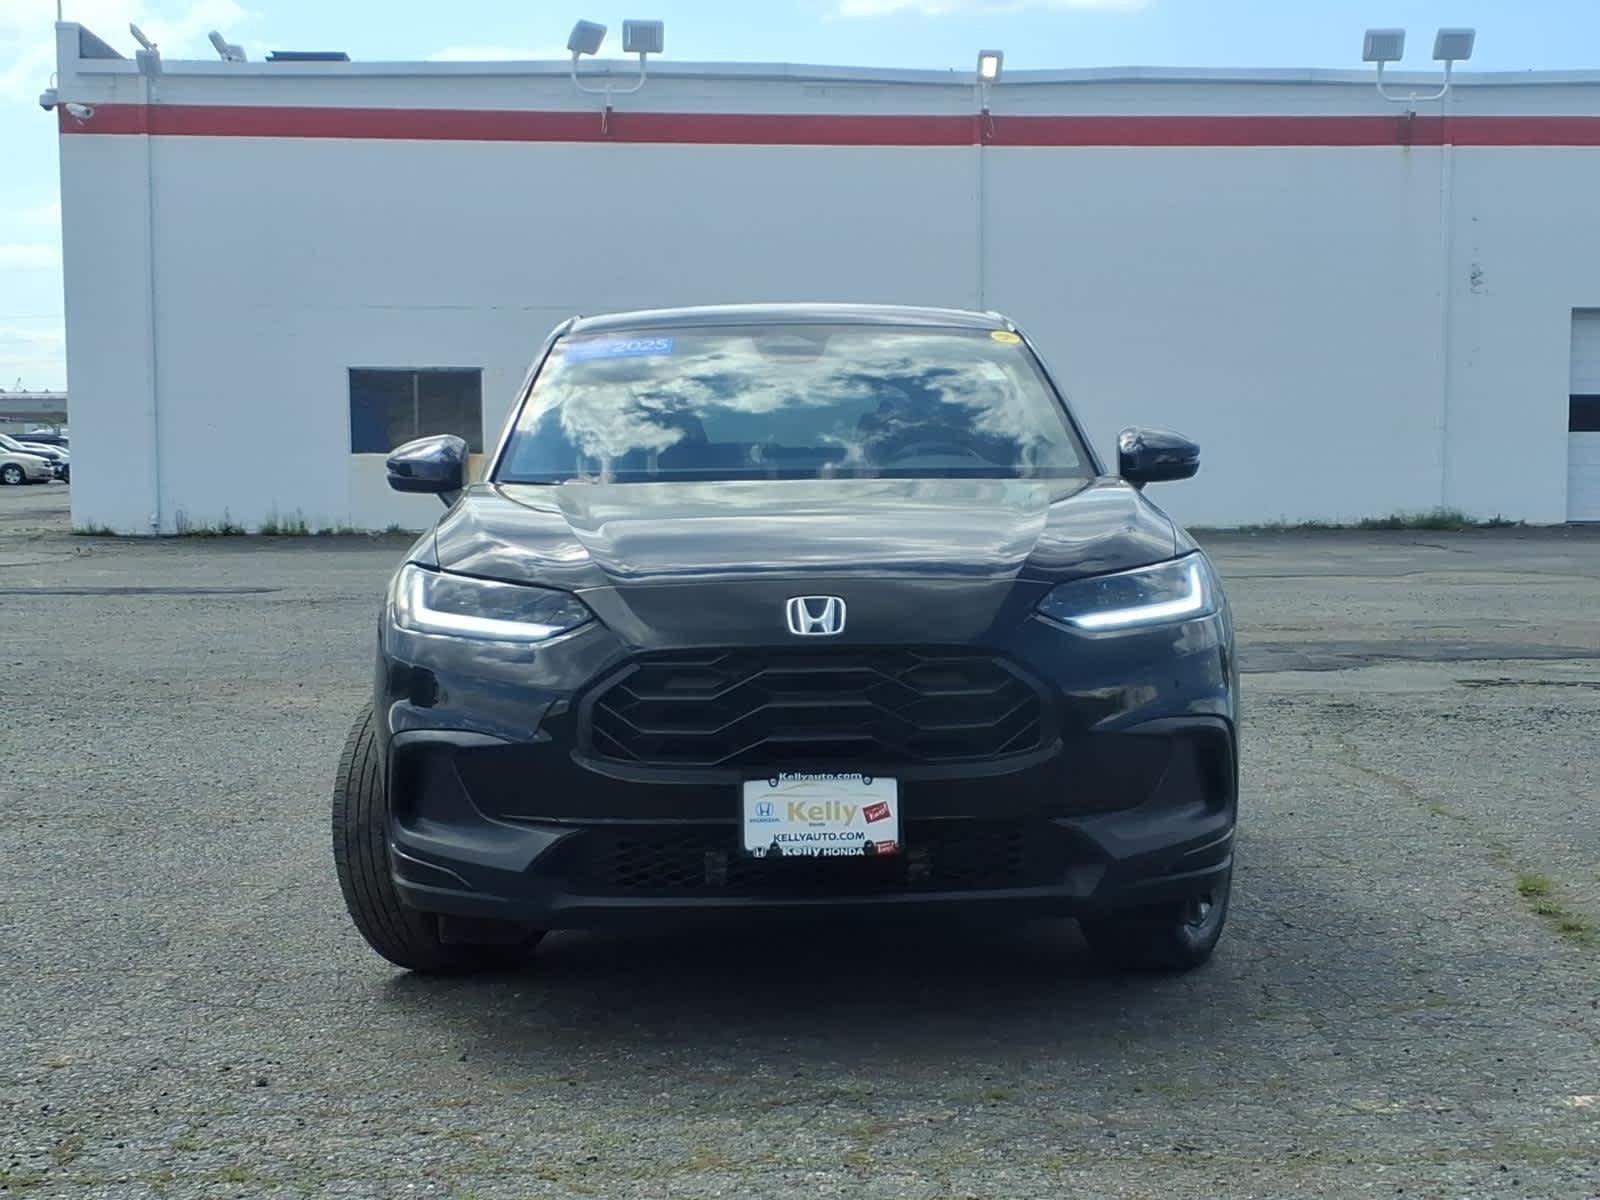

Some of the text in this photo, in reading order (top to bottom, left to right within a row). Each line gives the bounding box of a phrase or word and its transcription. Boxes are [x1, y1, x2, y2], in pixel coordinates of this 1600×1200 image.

[613, 338, 668, 353] 2025
[779, 772, 862, 781] Kellyauto.com
[787, 801, 858, 827] Kelly
[774, 832, 865, 842] KELLYAUTO.COM
[782, 846, 865, 857] Kelly HONDA
